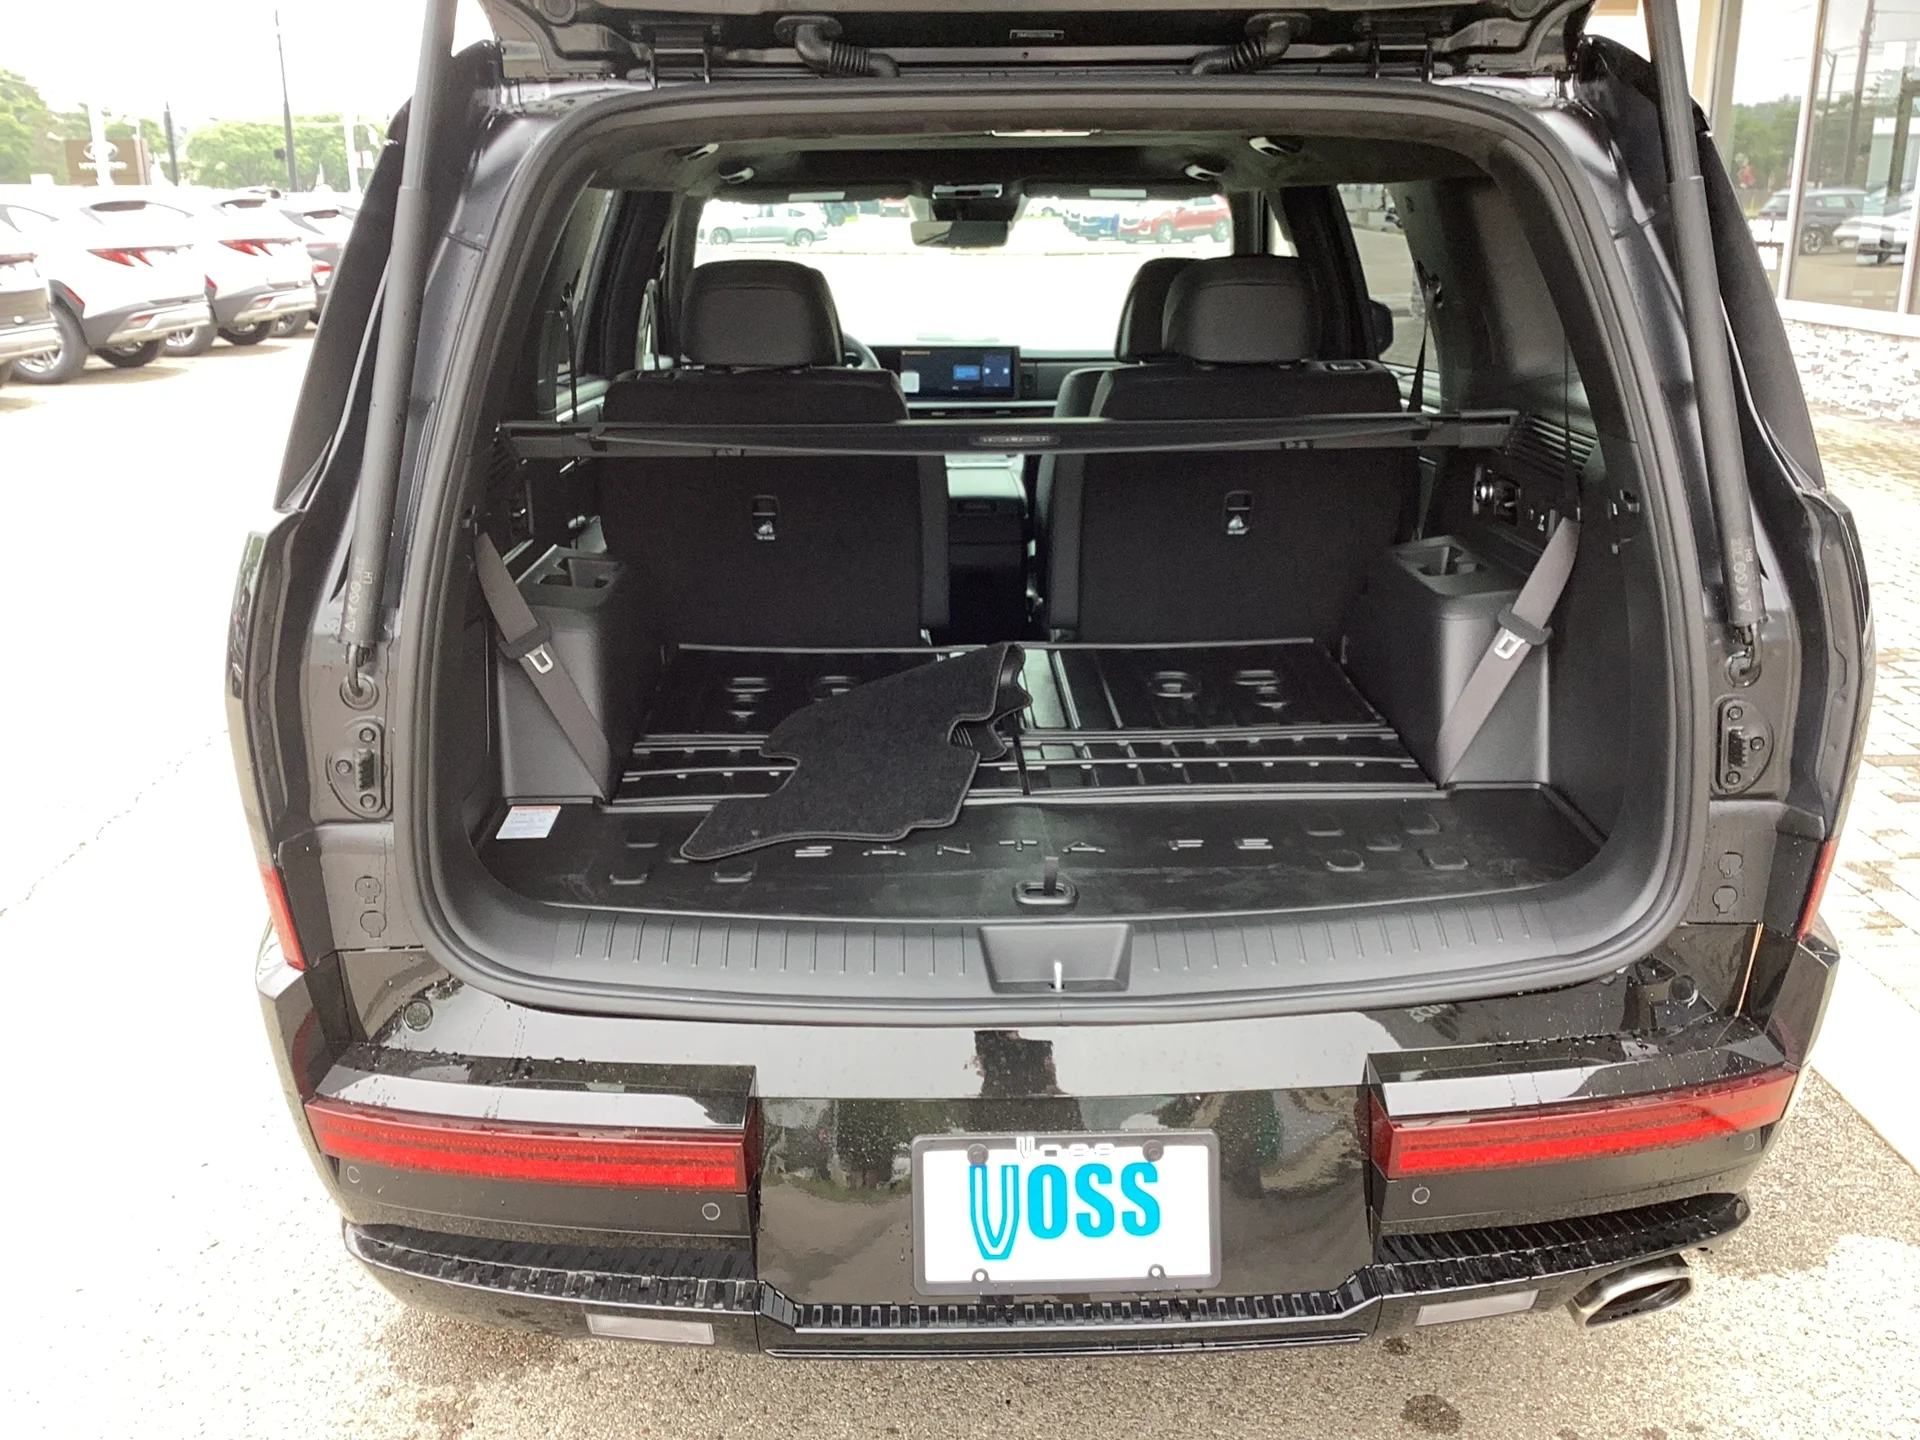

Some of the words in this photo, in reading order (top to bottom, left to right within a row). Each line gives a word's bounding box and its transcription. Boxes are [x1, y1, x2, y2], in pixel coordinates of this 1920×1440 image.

[363, 571, 373, 585] LH
[794, 839, 1106, 858] SANTA
[1168, 838, 1274, 851] FE
[969, 1162, 1161, 1260] VOSS
